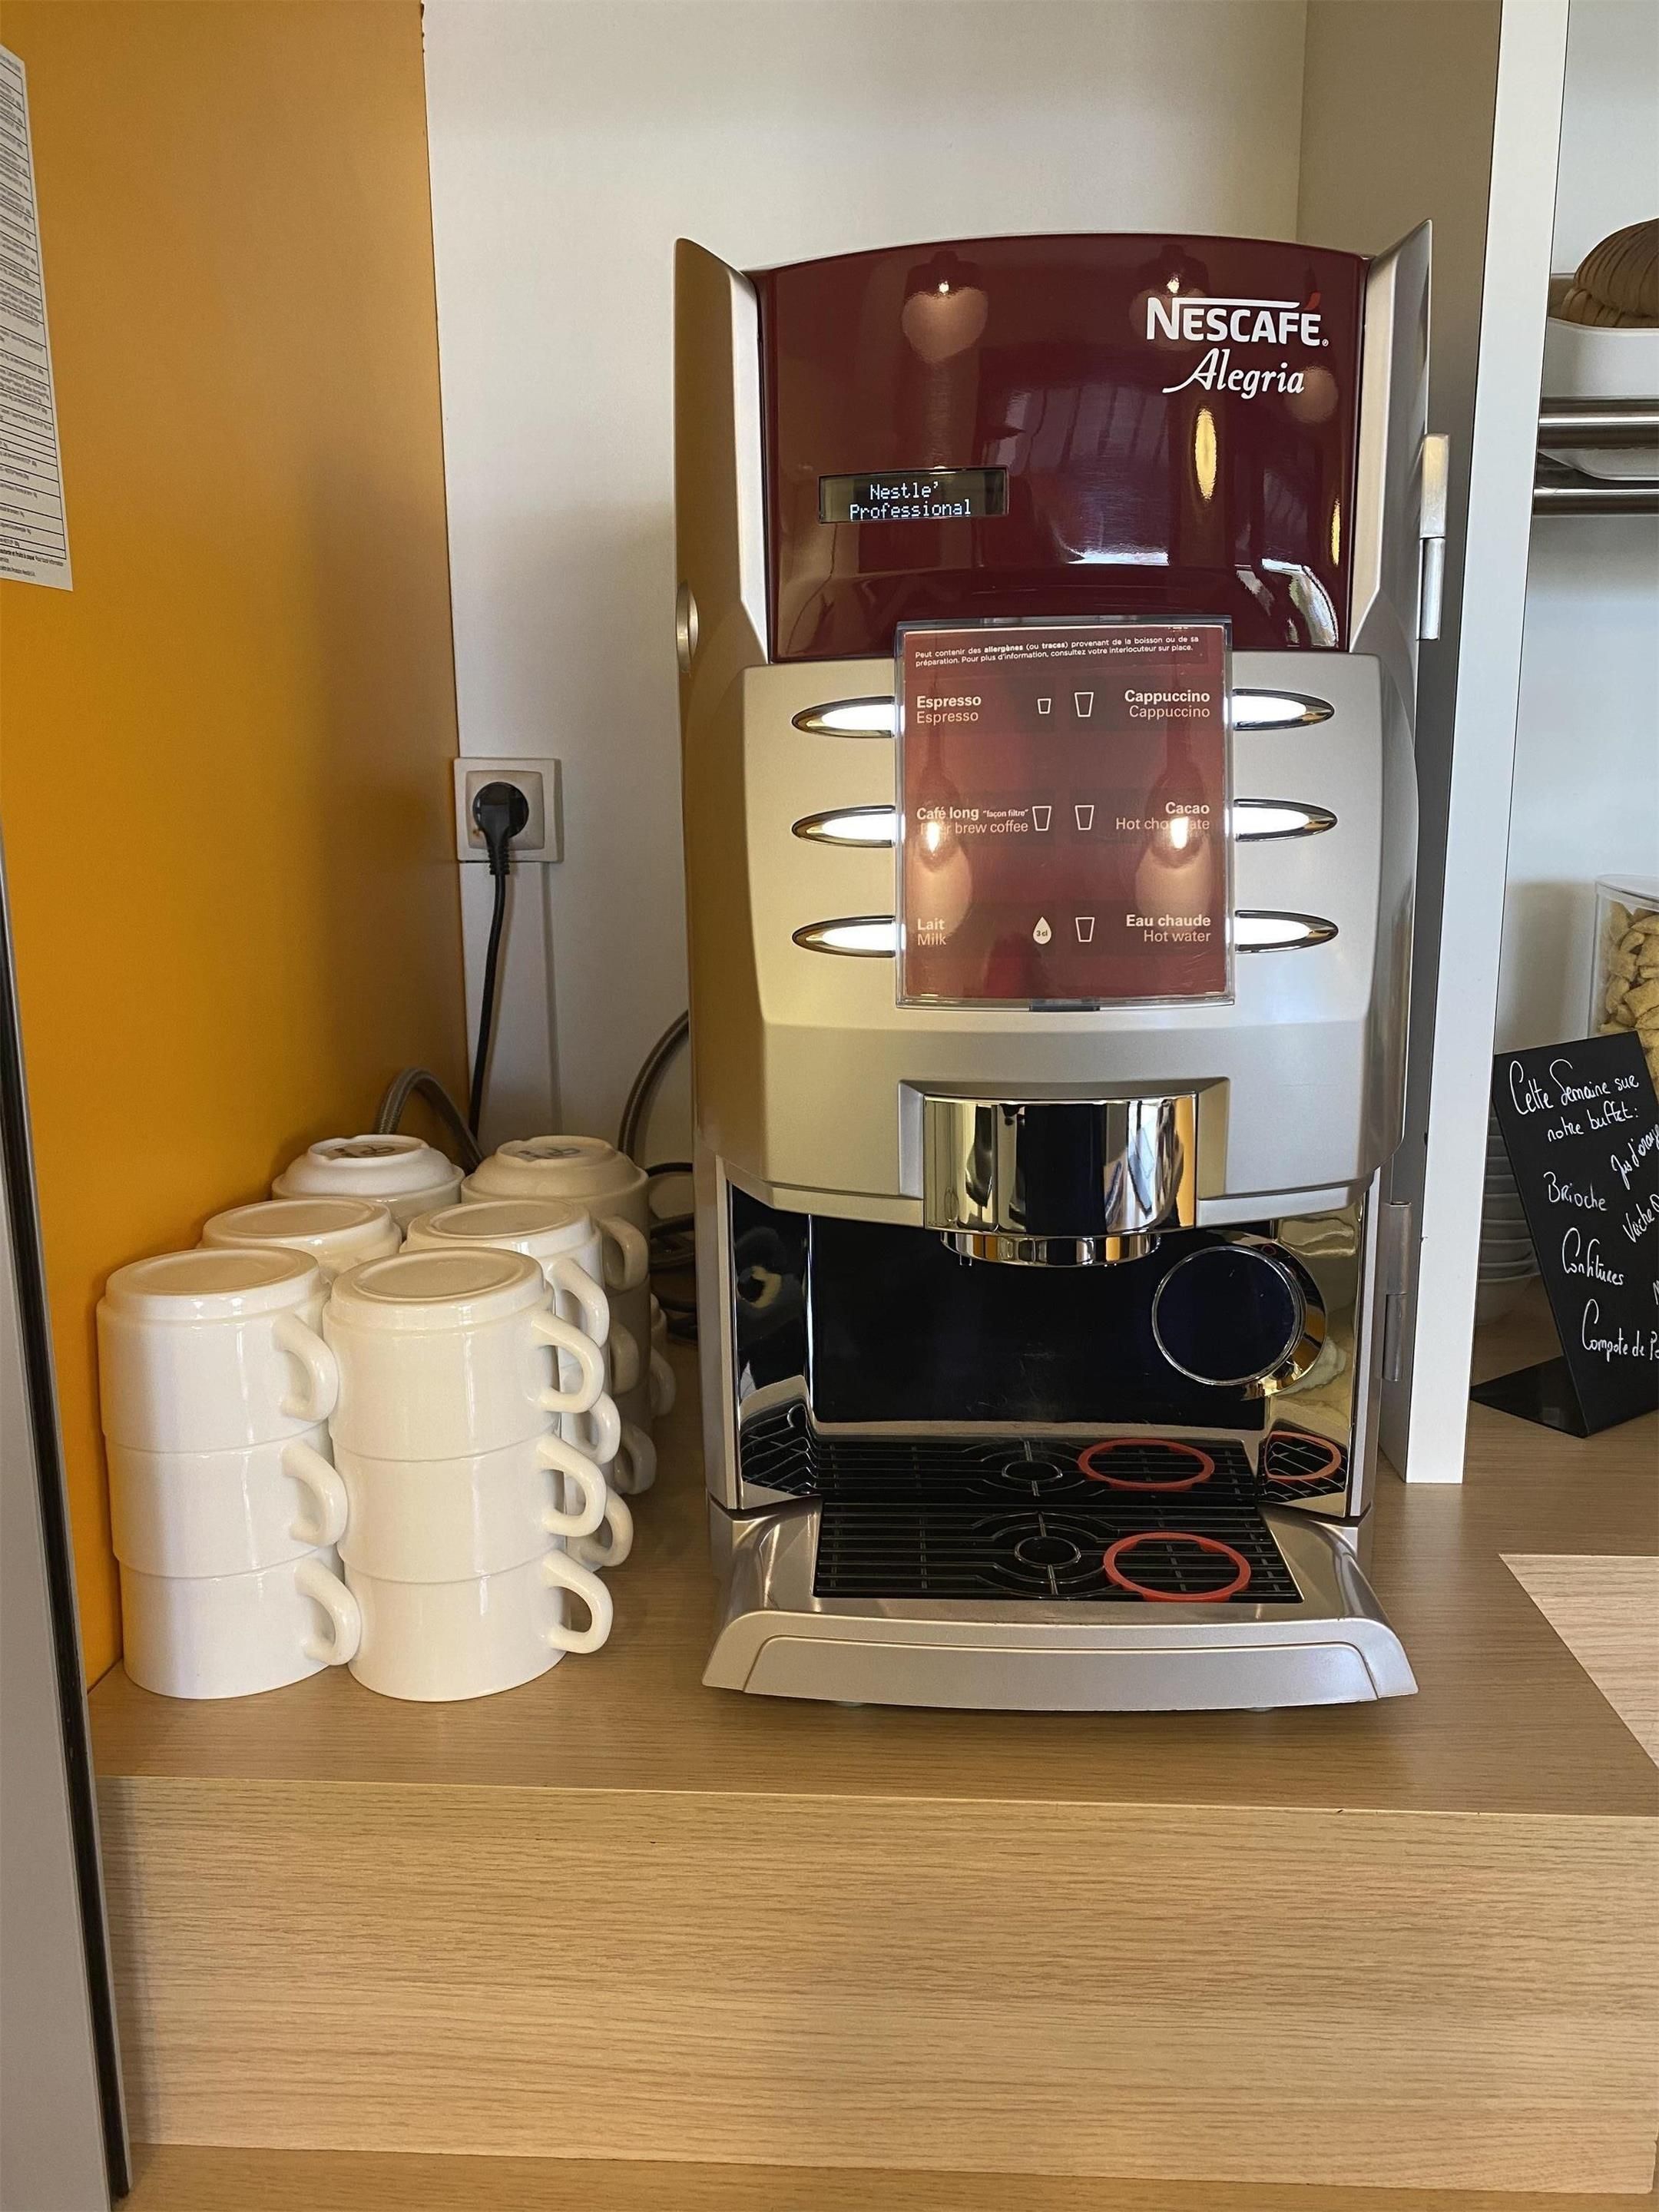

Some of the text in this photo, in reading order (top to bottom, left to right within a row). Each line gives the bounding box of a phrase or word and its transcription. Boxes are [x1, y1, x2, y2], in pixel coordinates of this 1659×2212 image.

[1162, 347, 1305, 399] Alegria
[849, 498, 972, 522] Professional
[935, 648, 965, 657] contenir
[984, 644, 1024, 653] allergènes
[1026, 642, 1039, 651] (ou
[1041, 641, 1068, 650] traces)
[1071, 640, 1110, 648] provenant
[915, 657, 960, 667] préparation.
[1051, 648, 1086, 657] consultez
[916, 695, 982, 710] Espresso
[1124, 689, 1210, 705] Cappuccino
[916, 710, 979, 726] Espresso
[1129, 705, 1210, 720] Cappuccino
[916, 806, 946, 820] Café
[949, 806, 979, 821] long
[1165, 801, 1210, 814] Cacao
[920, 820, 1028, 835] Fer brew coffee
[1115, 816, 1210, 830] Hot choate
[916, 918, 945, 931] Lait
[1126, 914, 1211, 927] Eau chaude
[916, 932, 947, 946] Milk
[1144, 929, 1211, 942] Hot water
[1509, 1060, 1554, 1115] Cette
[1547, 1116, 1584, 1143] notre
[1610, 1154, 1633, 1190] Jus
[1543, 1171, 1608, 1211] Brioche
[1622, 1203, 1655, 1243] Vache
[1562, 1227, 1624, 1285] Confitures
[1582, 1298, 1628, 1363] Compote
[1631, 1330, 1645, 1357] de
